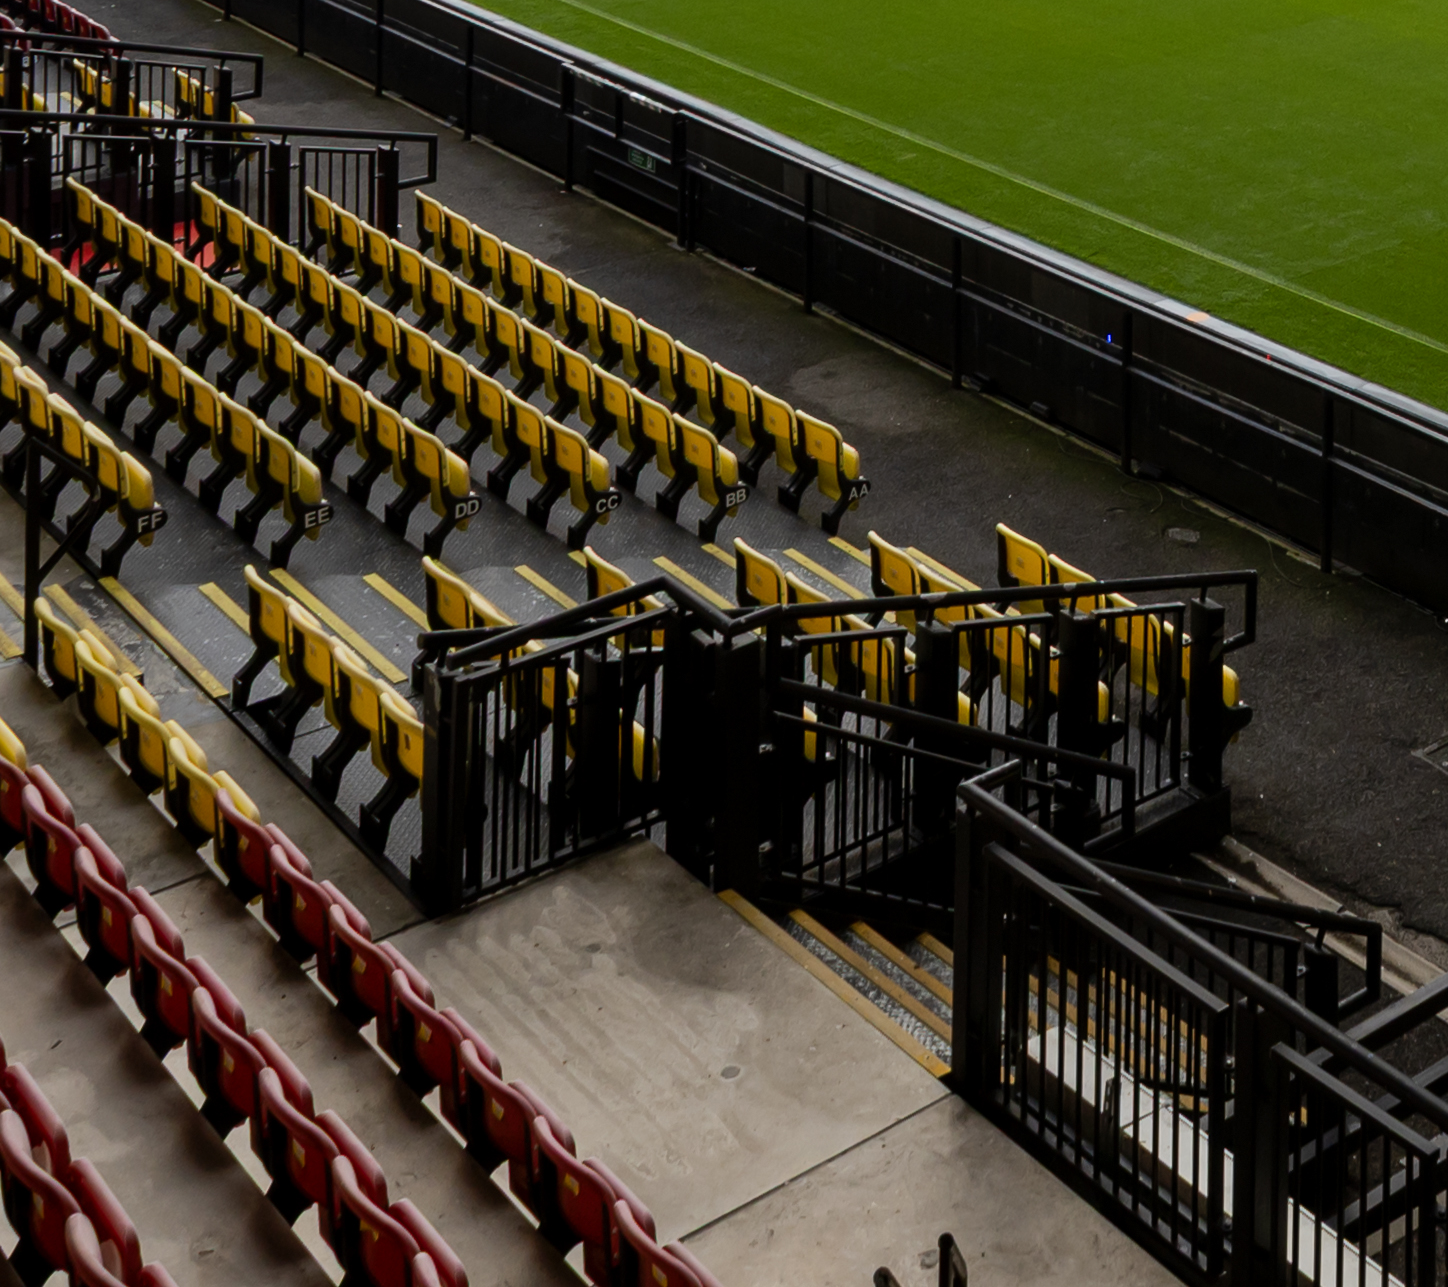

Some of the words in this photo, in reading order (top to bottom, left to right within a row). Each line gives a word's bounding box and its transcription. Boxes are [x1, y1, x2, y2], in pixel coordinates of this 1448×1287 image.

[726, 487, 746, 508] BB
[848, 483, 869, 501] AA
[455, 499, 480, 519] DD
[595, 494, 619, 513] CC
[138, 510, 163, 534] FF
[304, 505, 330, 529] EE
